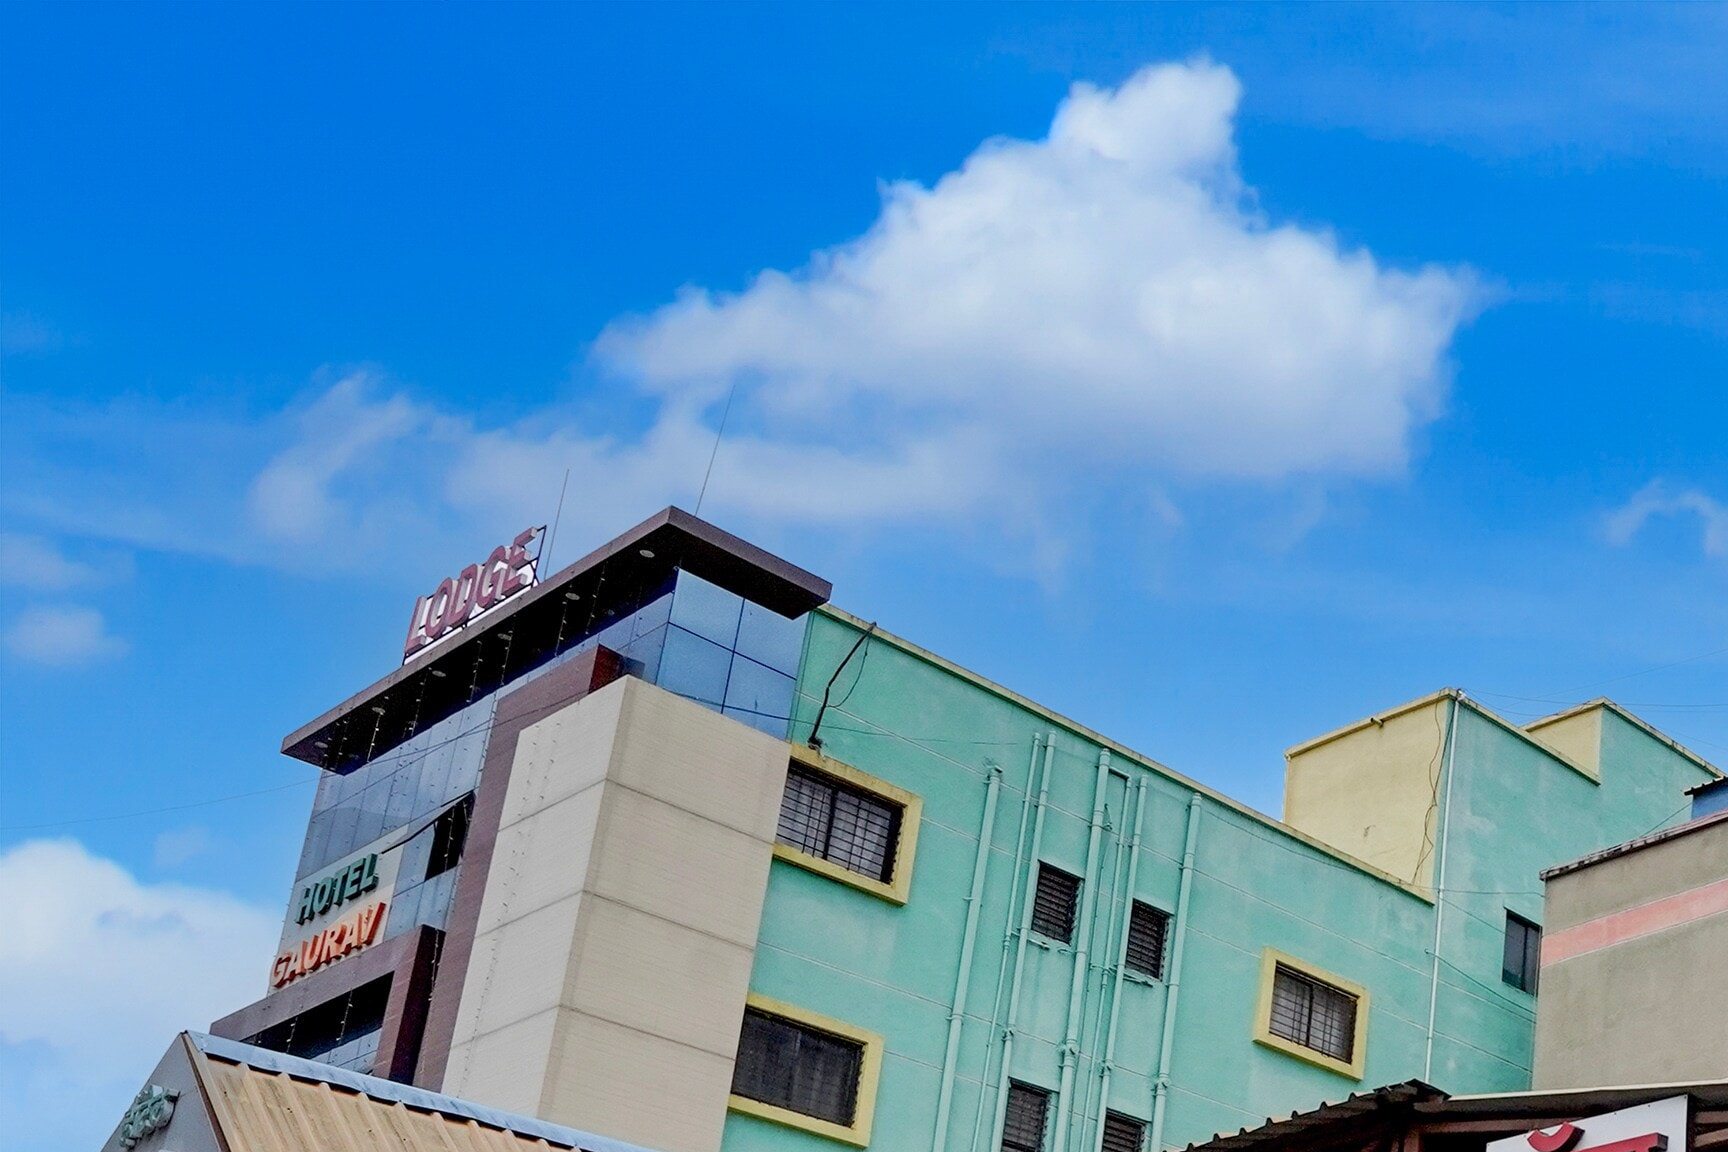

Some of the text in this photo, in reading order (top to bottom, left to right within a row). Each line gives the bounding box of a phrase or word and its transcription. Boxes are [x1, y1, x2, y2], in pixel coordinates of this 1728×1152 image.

[405, 527, 537, 655] LODGE
[296, 853, 378, 926] HOTEL
[274, 902, 386, 988] GAURAV
